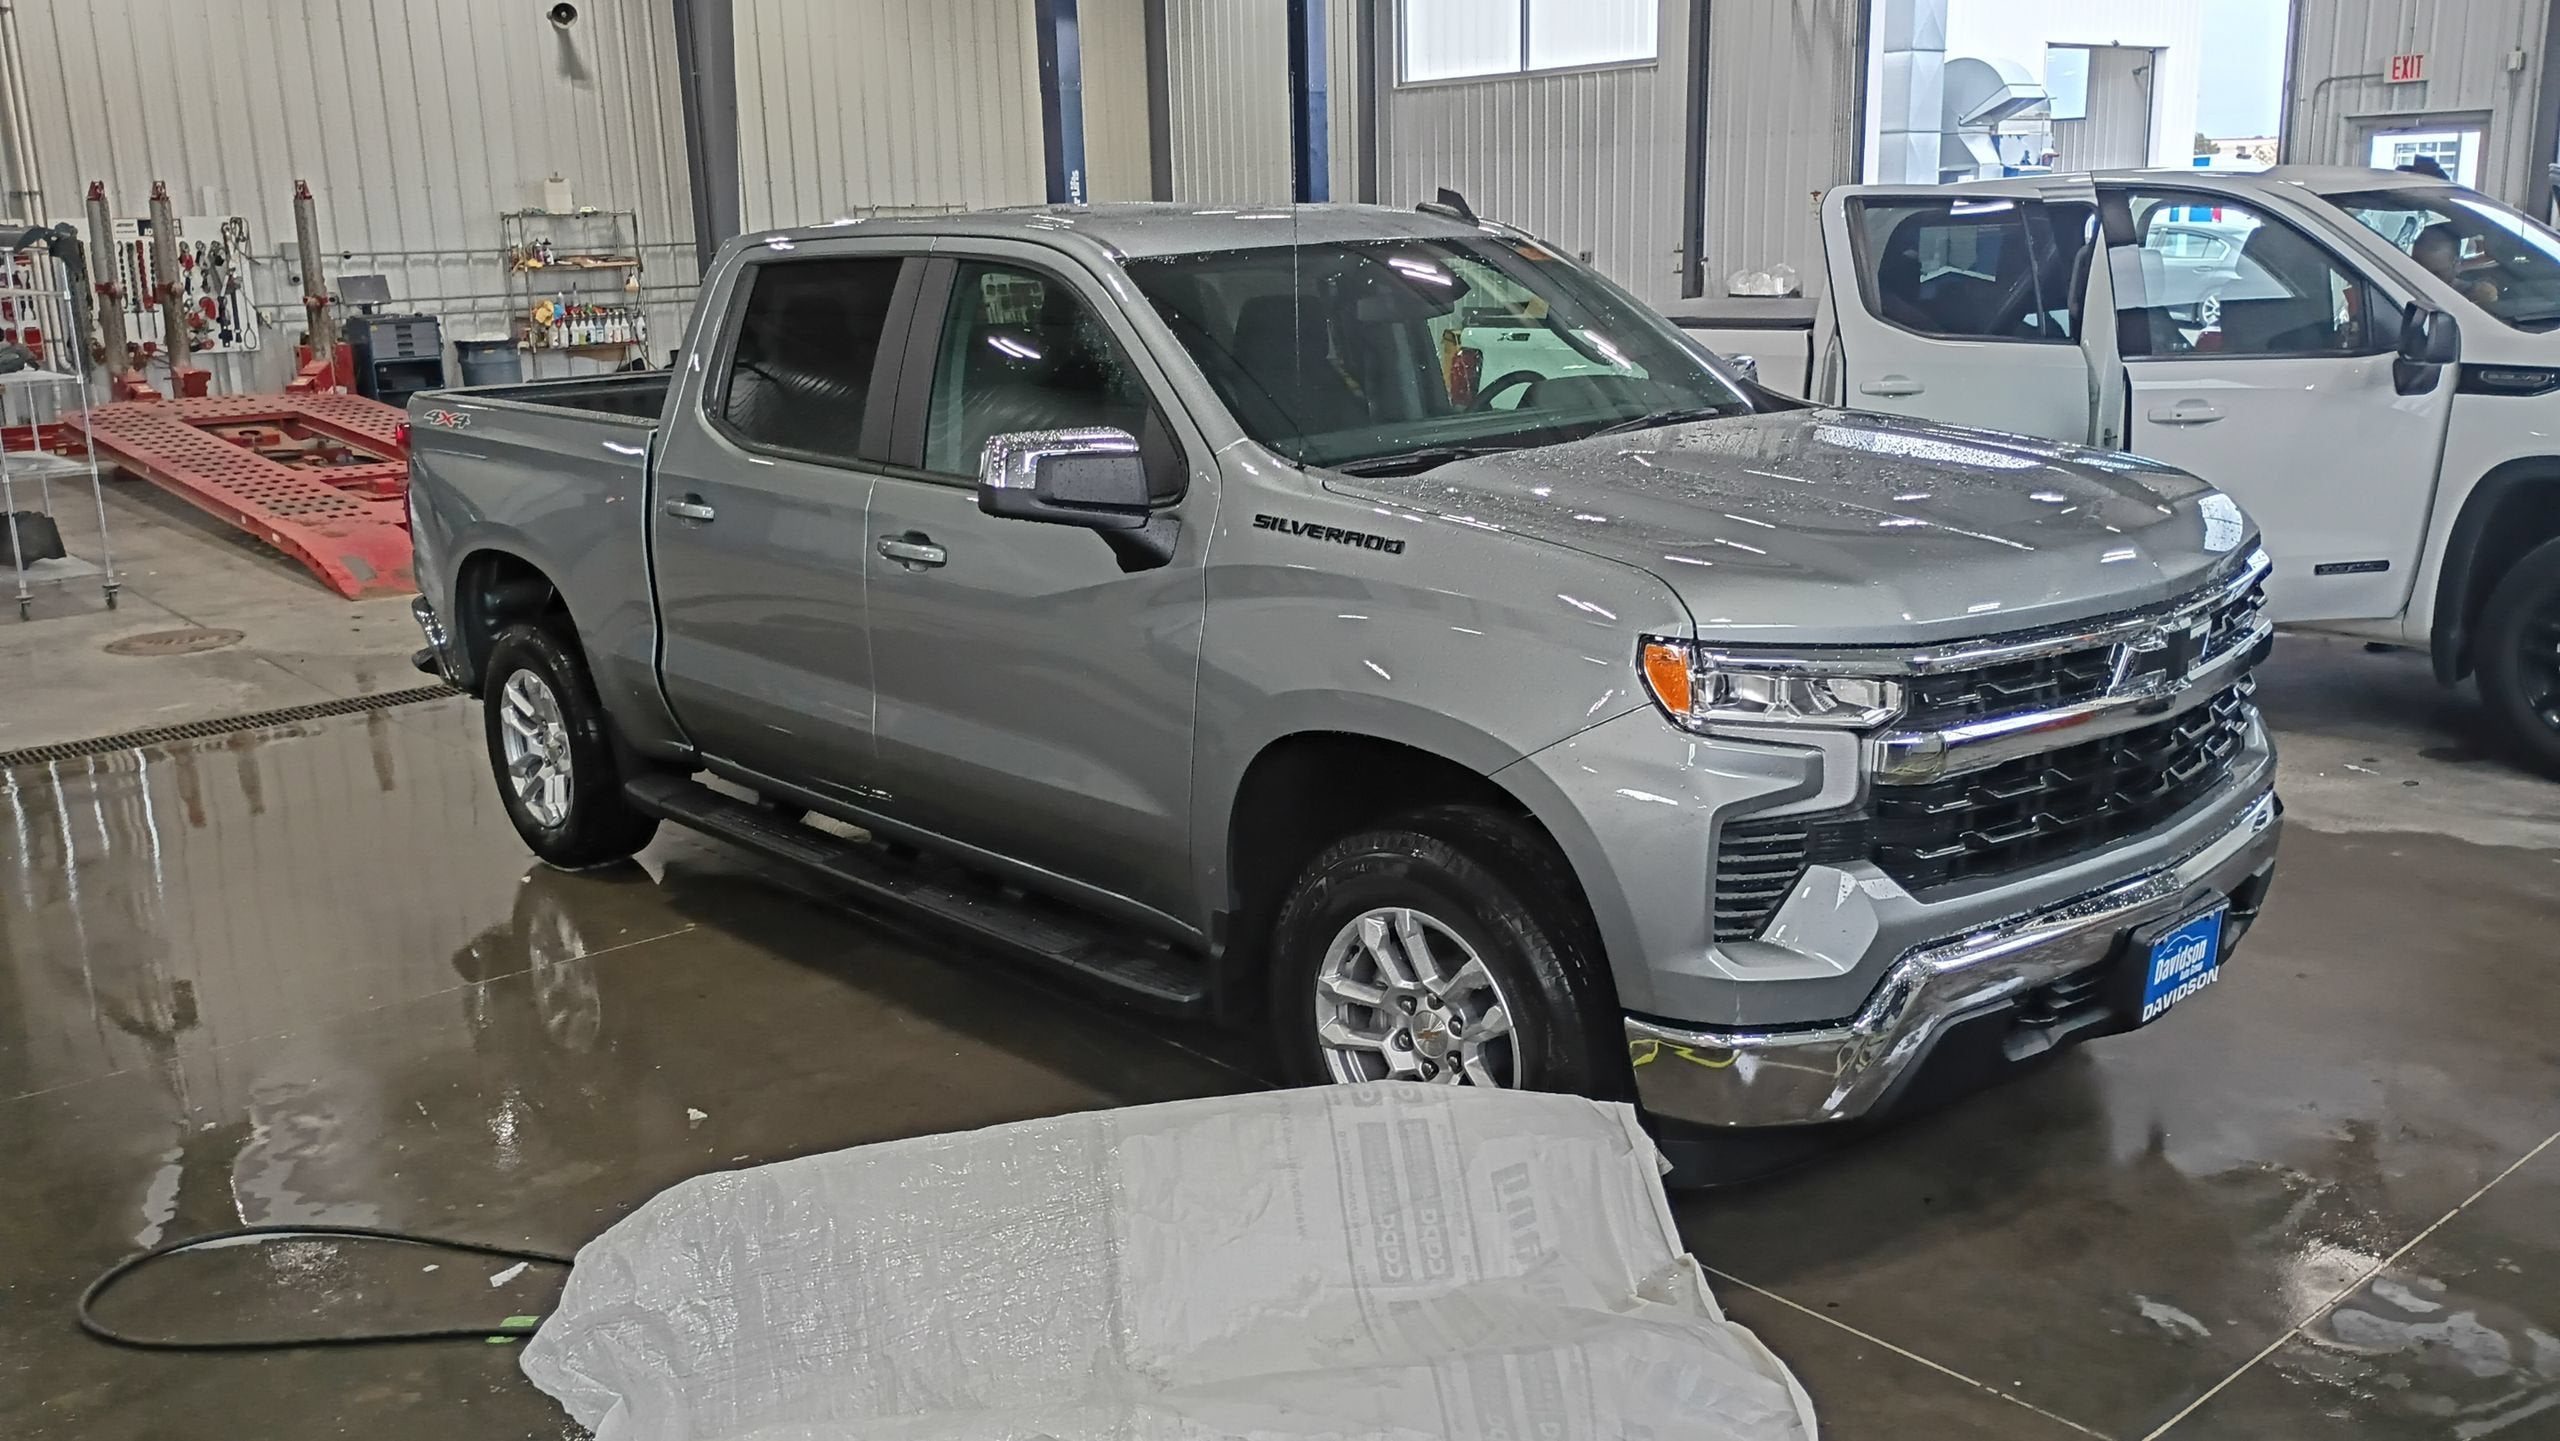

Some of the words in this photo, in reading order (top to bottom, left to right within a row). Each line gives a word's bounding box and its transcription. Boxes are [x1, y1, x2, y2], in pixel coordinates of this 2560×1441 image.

[2392, 55, 2424, 80] EXIT
[1253, 514, 1405, 554] SILVERADO
[2153, 939, 2208, 986] Davidson
[2142, 965, 2219, 1022] DAVIDSON
